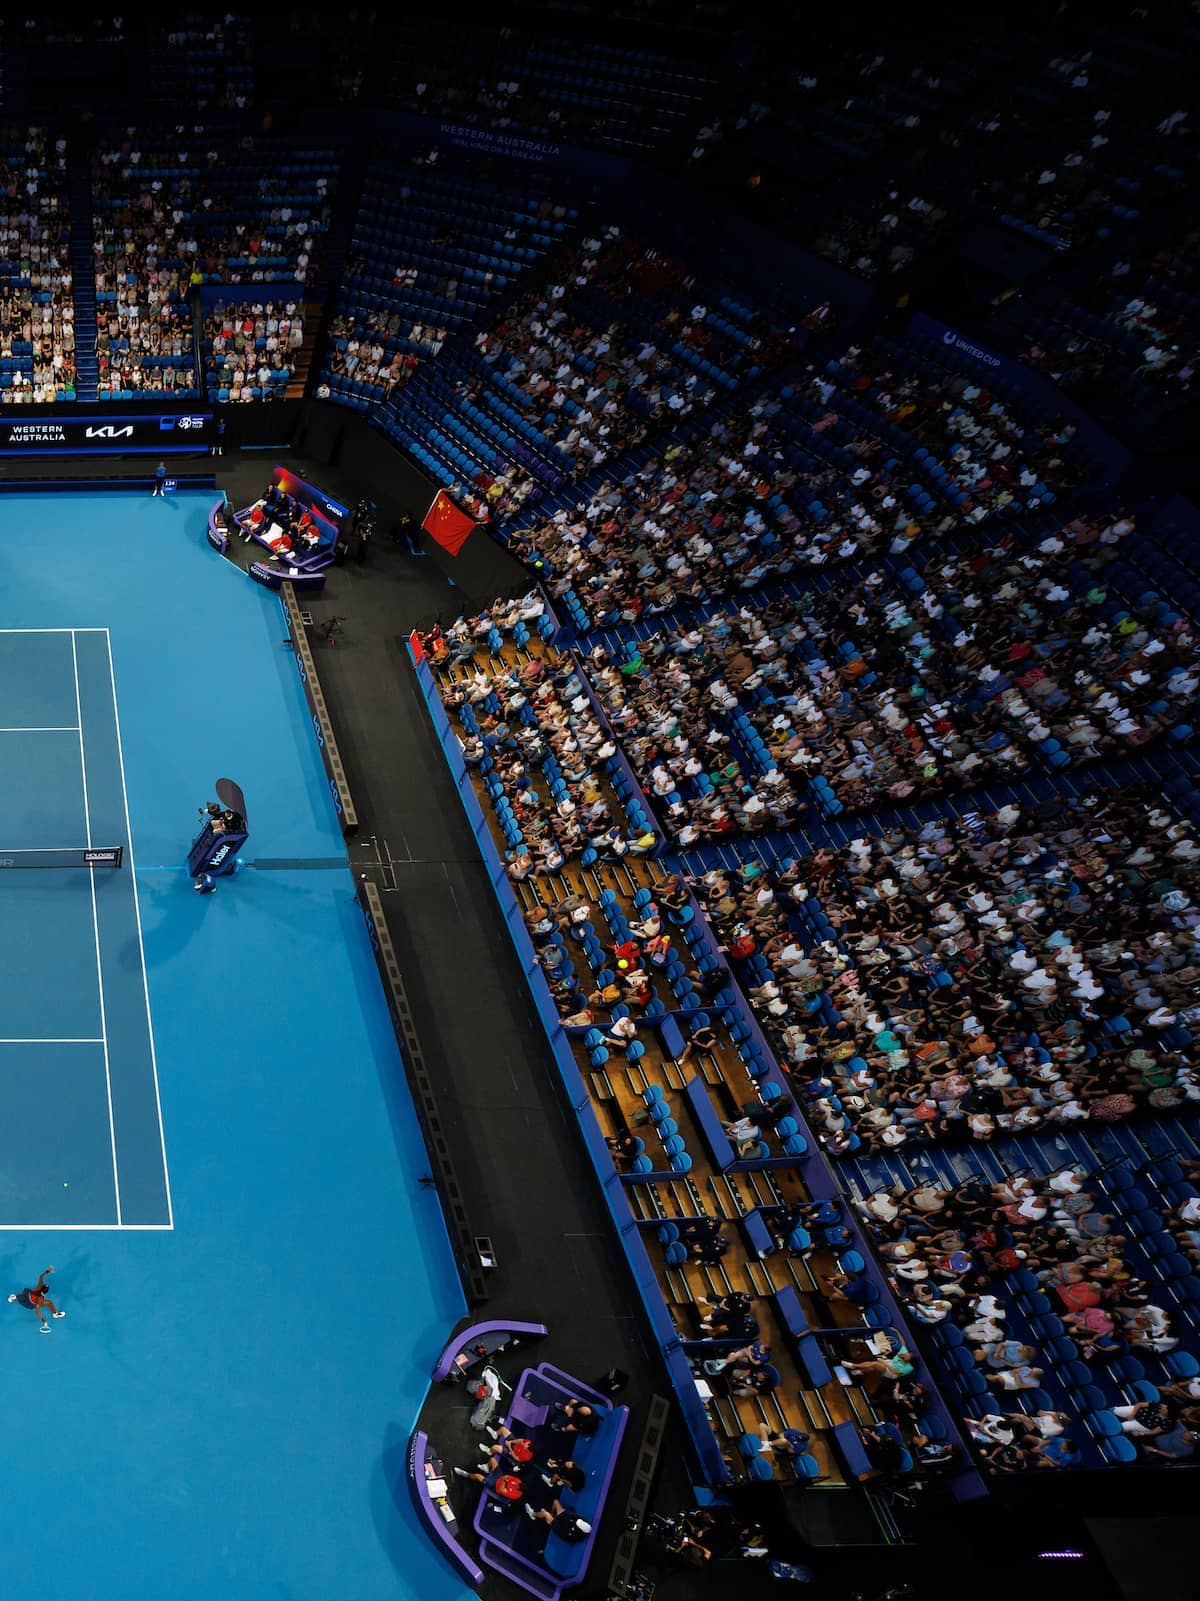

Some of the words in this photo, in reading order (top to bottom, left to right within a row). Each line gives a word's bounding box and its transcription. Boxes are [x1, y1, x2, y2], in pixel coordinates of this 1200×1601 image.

[440, 121, 496, 141] WESTERN
[496, 134, 560, 155] AUSTRALIA
[955, 338, 984, 359] UNITED
[983, 354, 1001, 367] CUP
[9, 434, 66, 442] AUSTRALIA
[209, 844, 231, 866] Haier
